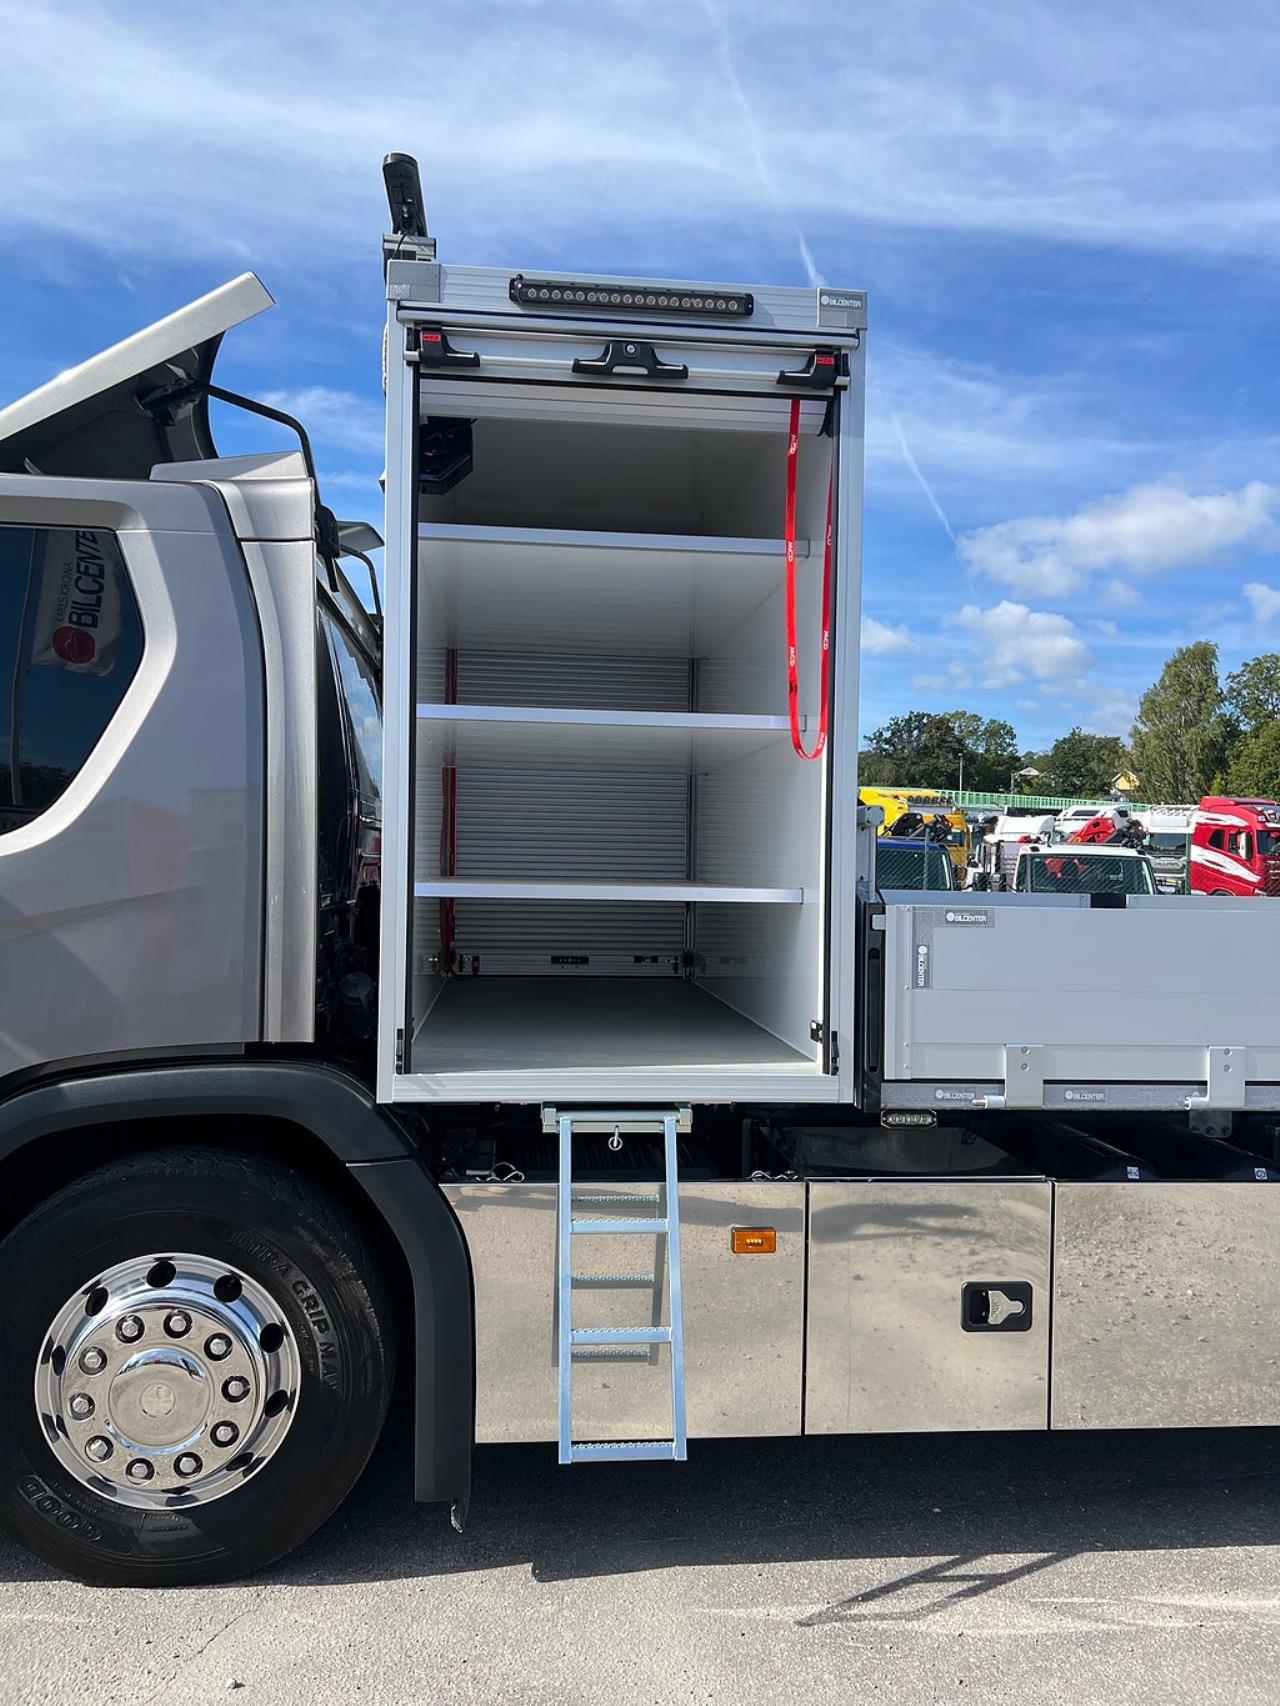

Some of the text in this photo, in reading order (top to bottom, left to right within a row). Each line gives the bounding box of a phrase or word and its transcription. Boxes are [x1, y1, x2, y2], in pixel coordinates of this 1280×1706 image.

[829, 298, 862, 308] BILCENTER
[55, 562, 73, 623] KARLSKRONA
[943, 1091, 976, 1100] BILCENTER
[1073, 1092, 1105, 1101] BILCENTER
[292, 1280, 331, 1335] GRIP
